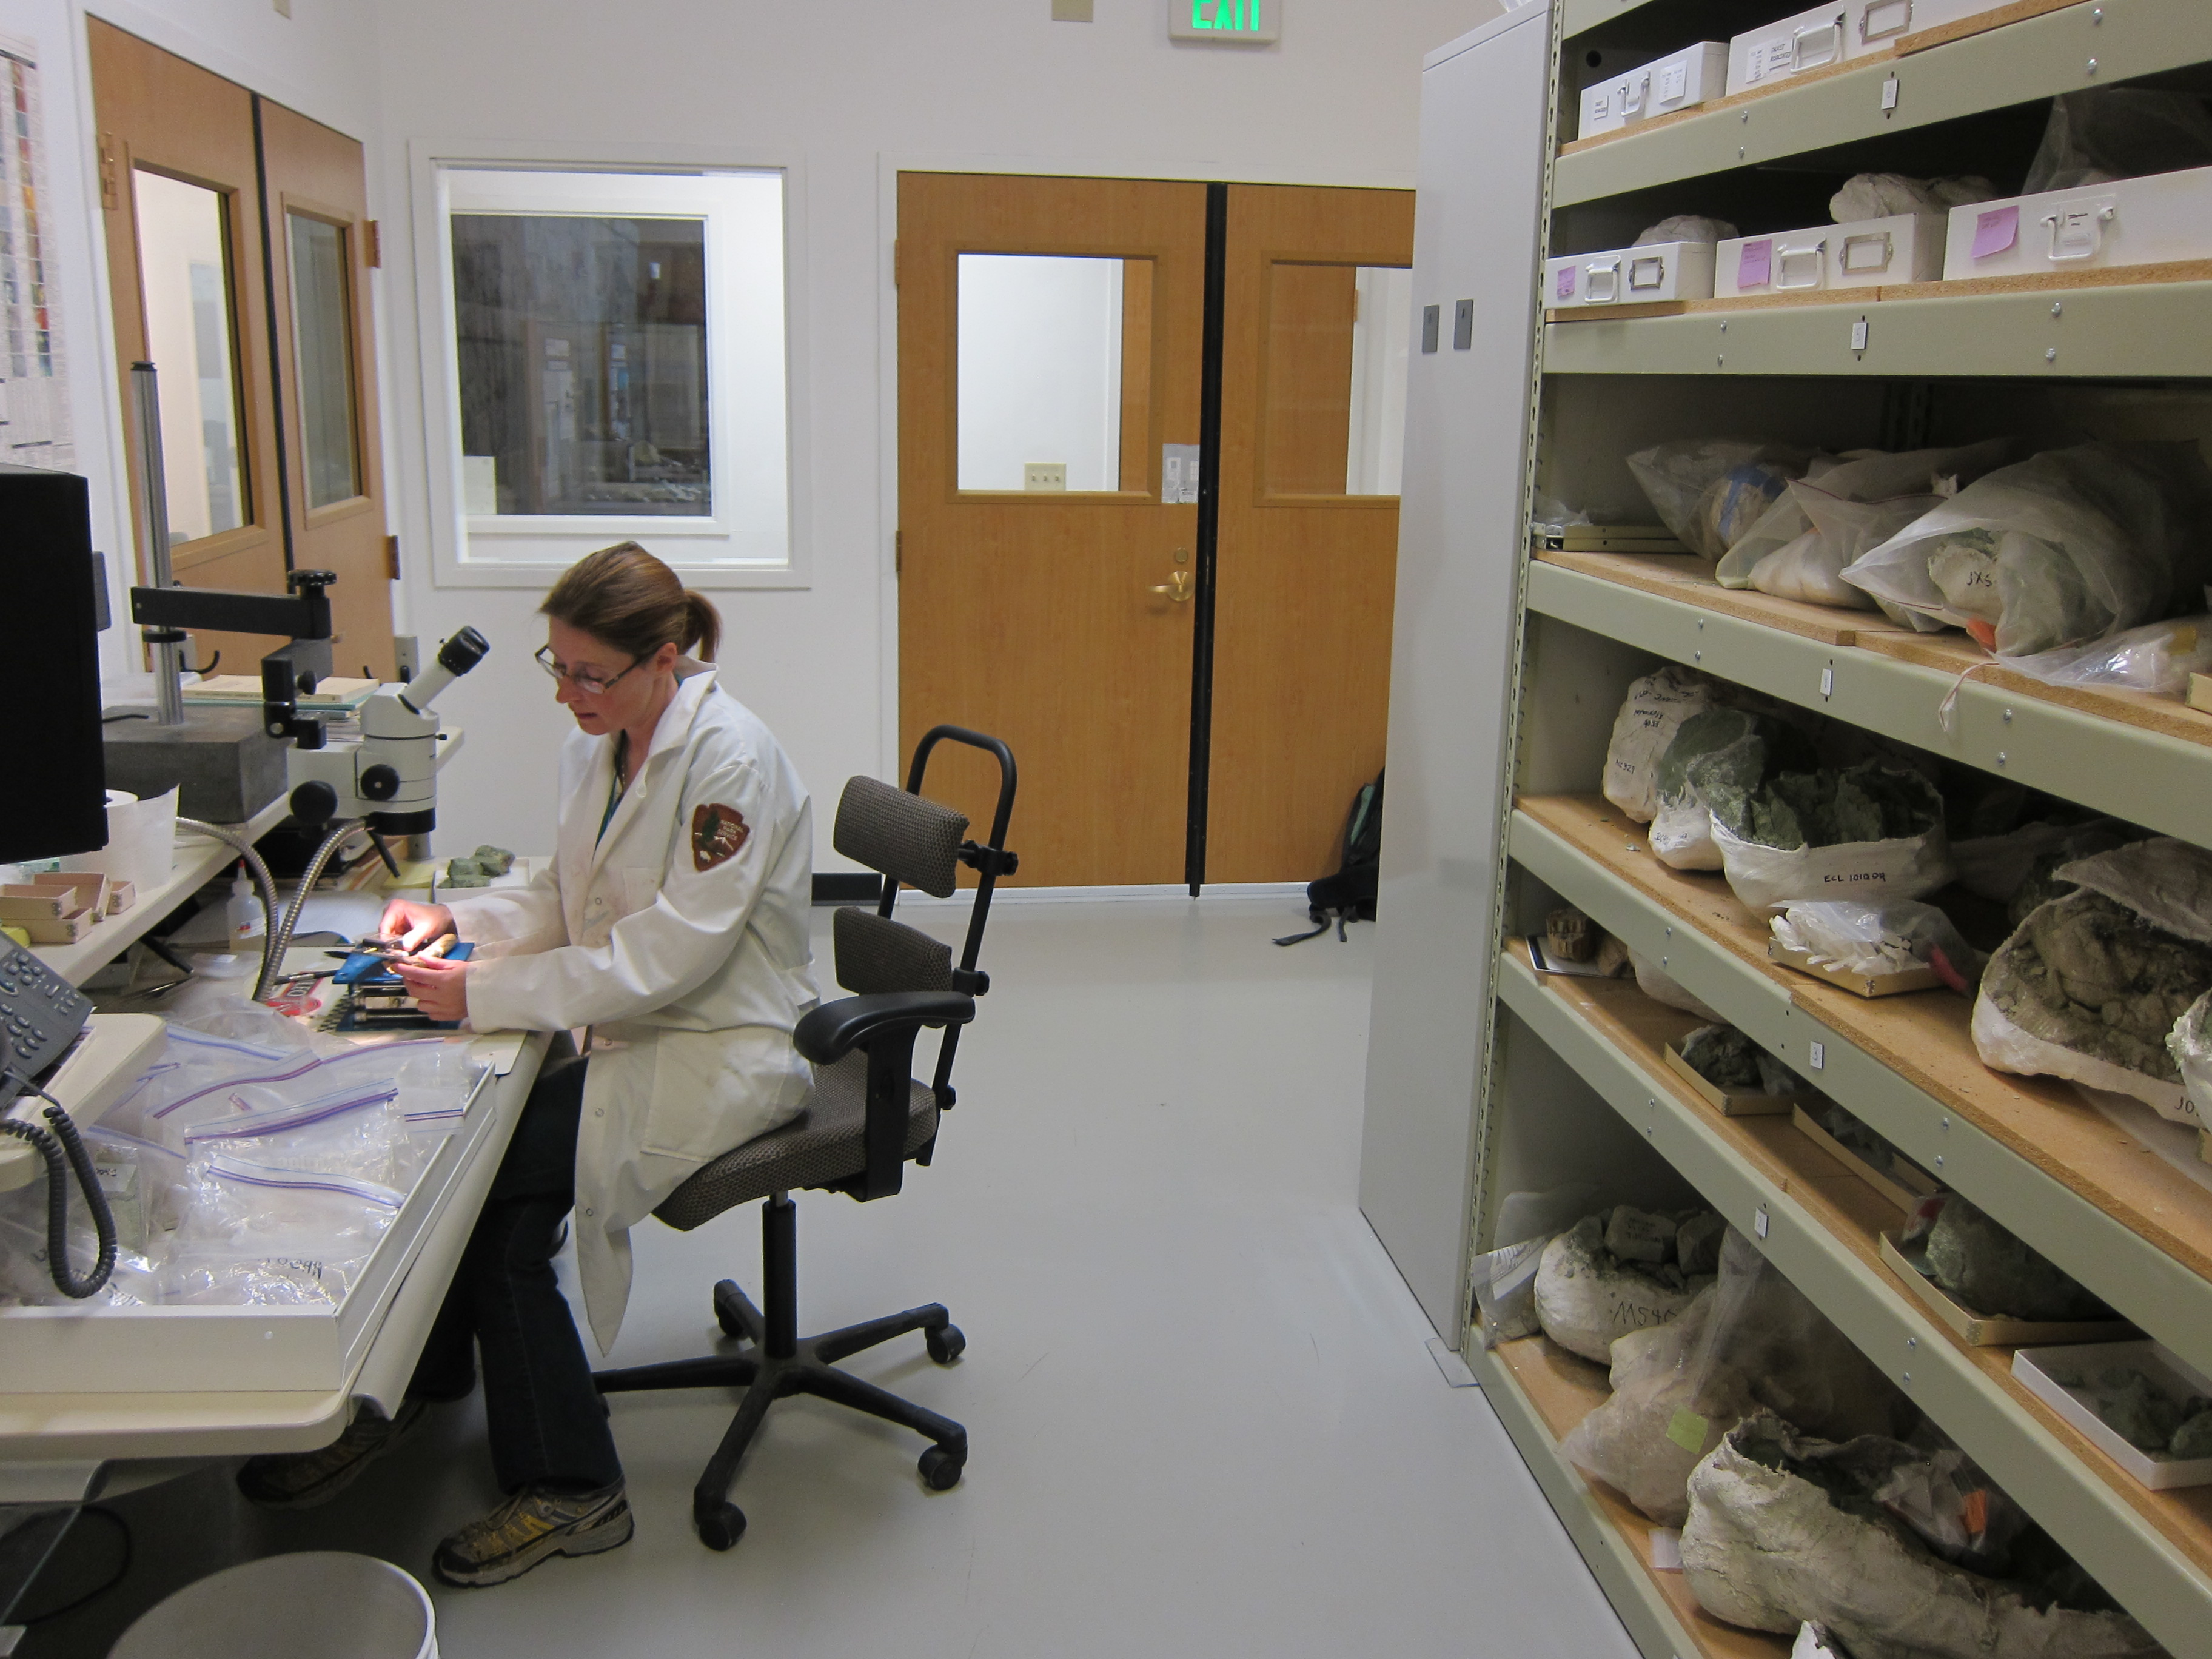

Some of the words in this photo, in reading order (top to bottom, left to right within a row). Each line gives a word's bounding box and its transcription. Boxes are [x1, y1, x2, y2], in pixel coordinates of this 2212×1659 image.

[720, 820, 744, 833] NATIONAL
[723, 825, 736, 834] PARK
[717, 828, 738, 842] SERVICE
[1824, 874, 1844, 883] ECL
[1812, 1047, 1818, 1061] 3
